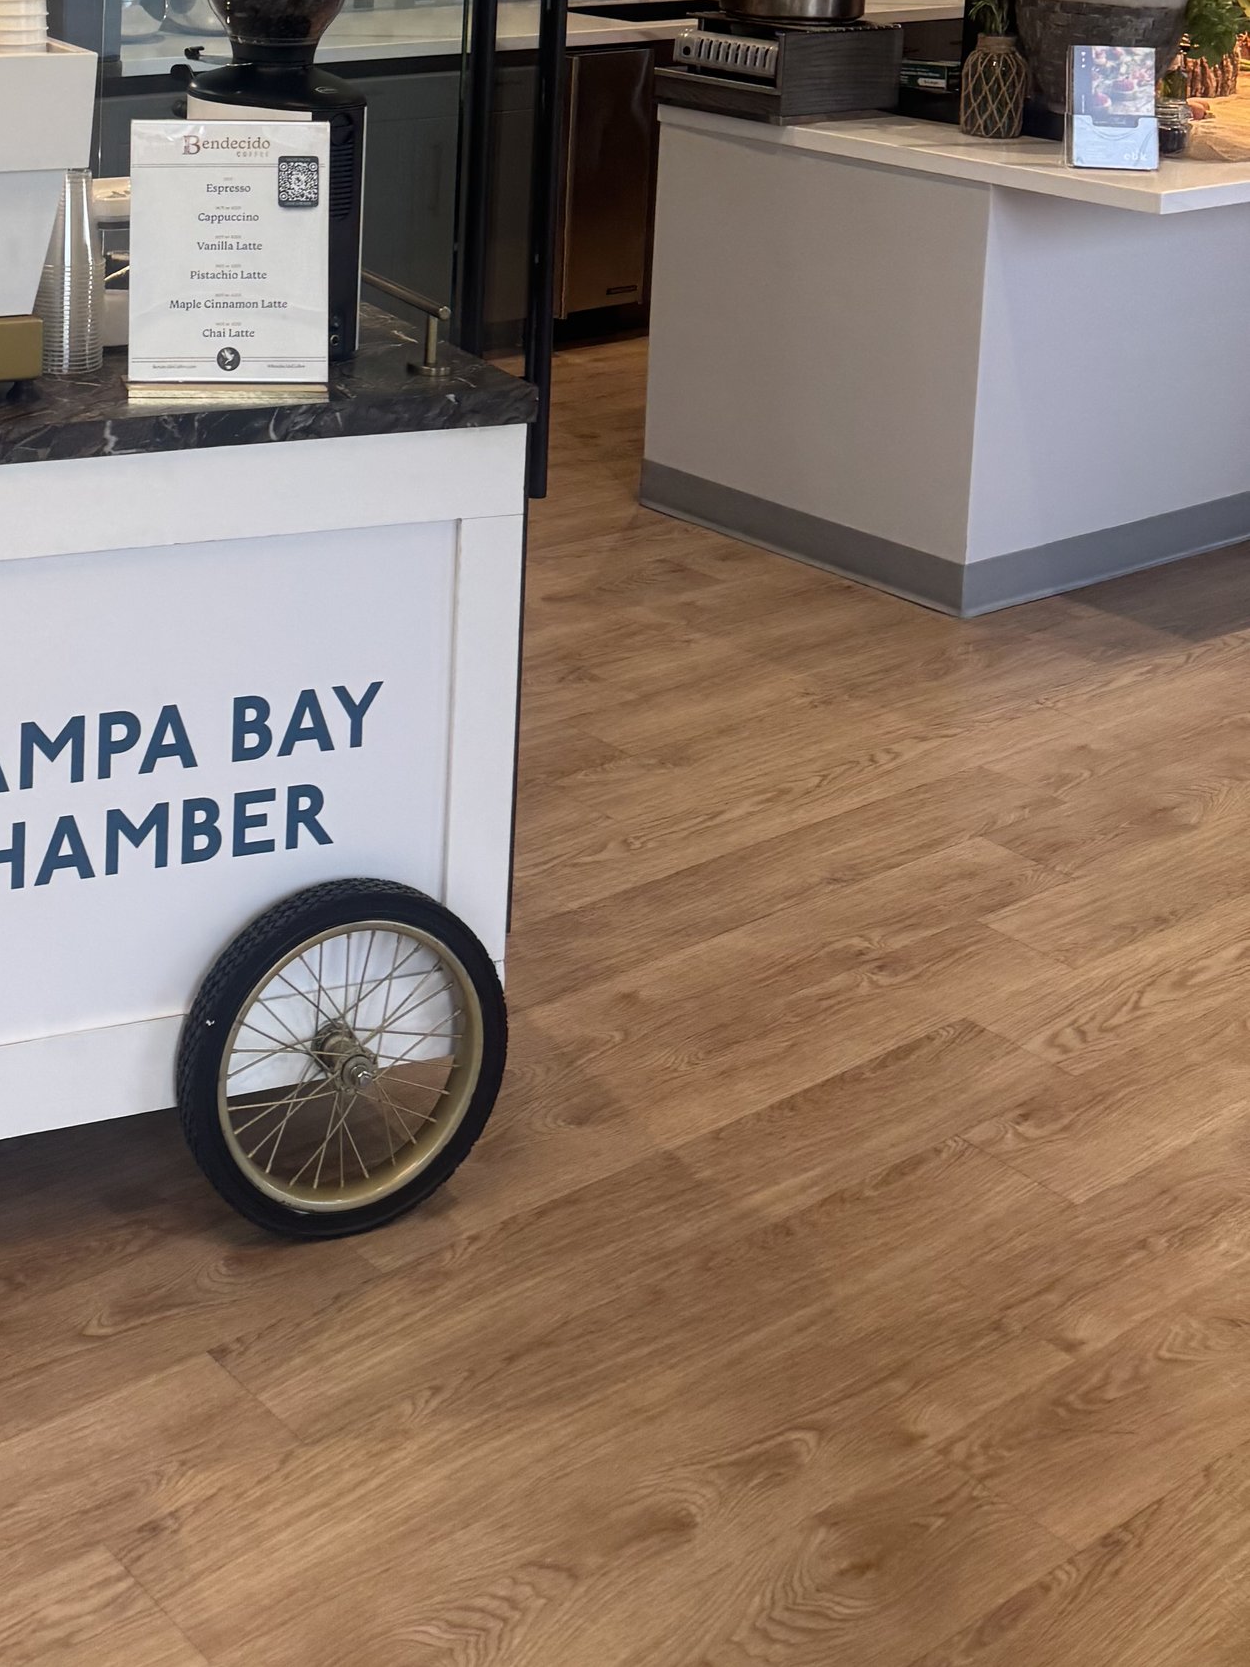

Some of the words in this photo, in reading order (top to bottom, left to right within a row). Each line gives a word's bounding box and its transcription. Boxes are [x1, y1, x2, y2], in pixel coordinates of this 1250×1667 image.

[182, 135, 271, 155] Bendecido
[206, 183, 251, 194] Espresso
[197, 212, 259, 224] Cappuccino
[197, 241, 234, 250] Vanilla
[236, 241, 263, 251] Latte
[190, 270, 238, 280] Pistachio
[240, 270, 267, 280] Latte
[169, 300, 202, 311] Maple
[204, 299, 259, 309] Cinnamon
[261, 299, 288, 309] Latte
[202, 328, 226, 338] Chai
[228, 328, 255, 338] Latte
[231, 680, 384, 763] BAY
